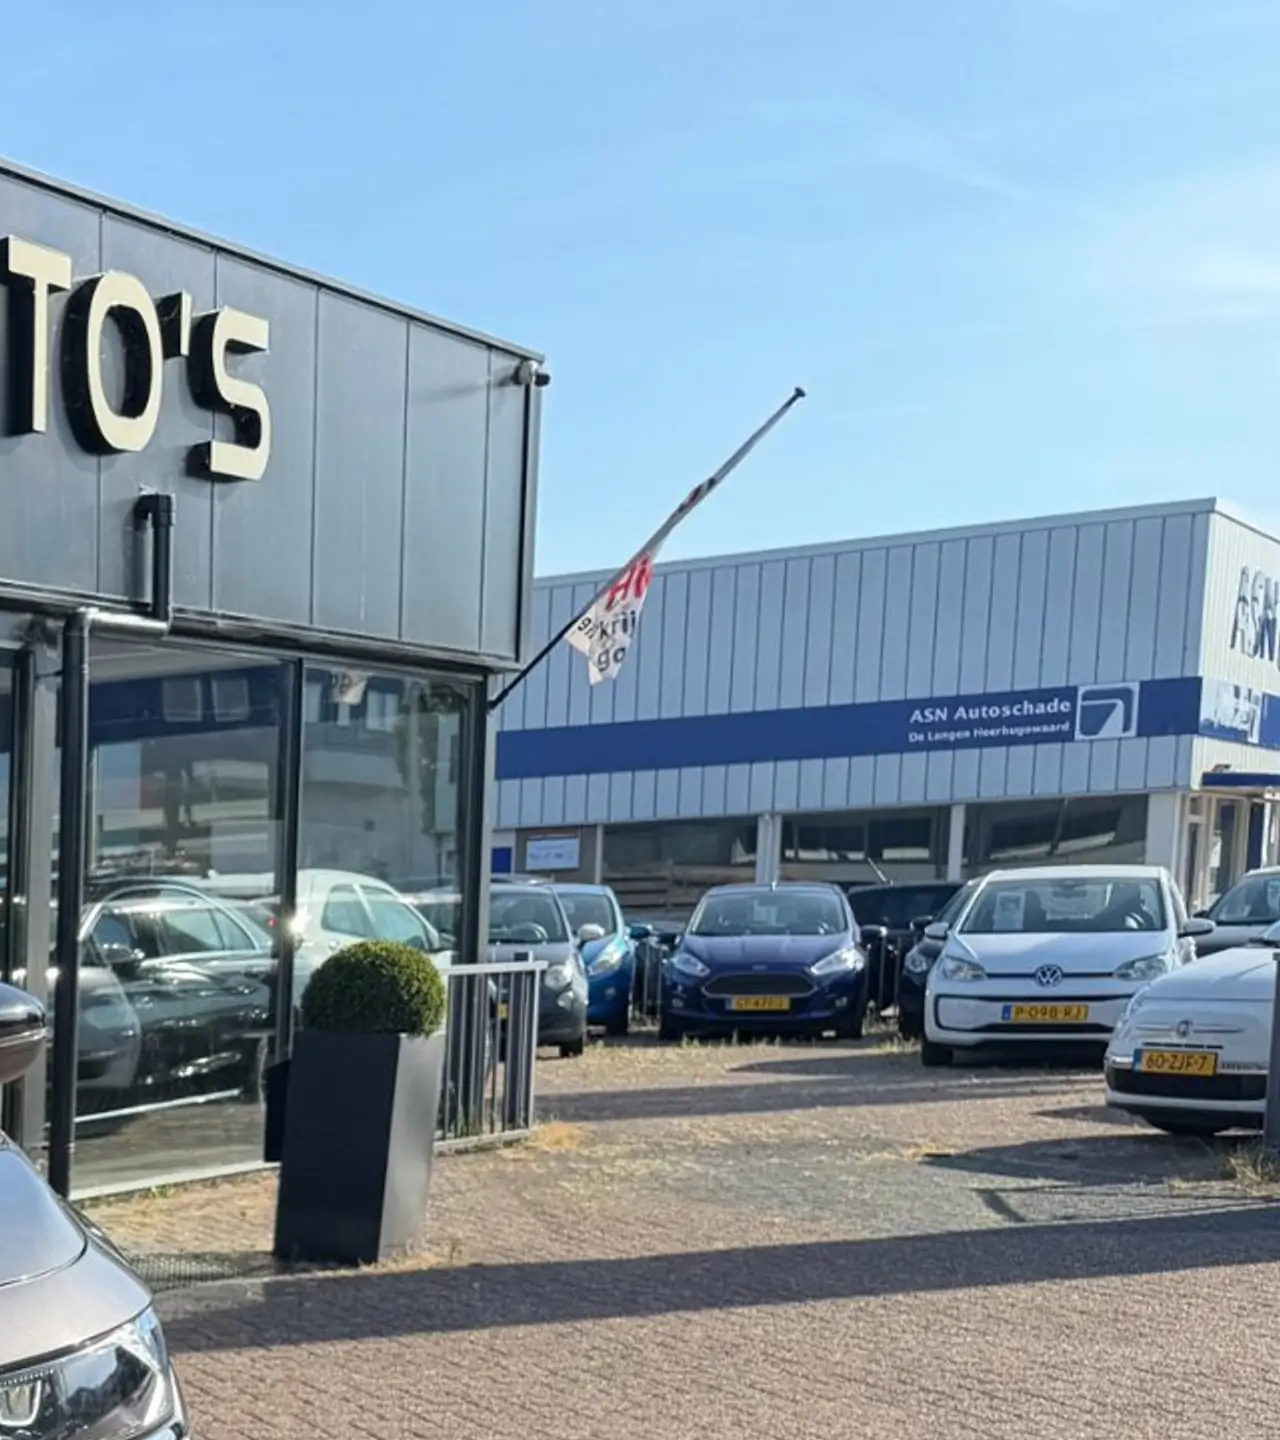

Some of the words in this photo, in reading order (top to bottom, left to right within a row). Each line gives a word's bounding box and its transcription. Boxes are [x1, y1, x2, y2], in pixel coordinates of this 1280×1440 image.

[909, 707, 948, 724] ASN
[953, 698, 1071, 721] Autoschade
[908, 731, 925, 743] De
[928, 729, 971, 742] Langen
[973, 721, 1070, 738] Heerhugowaard
